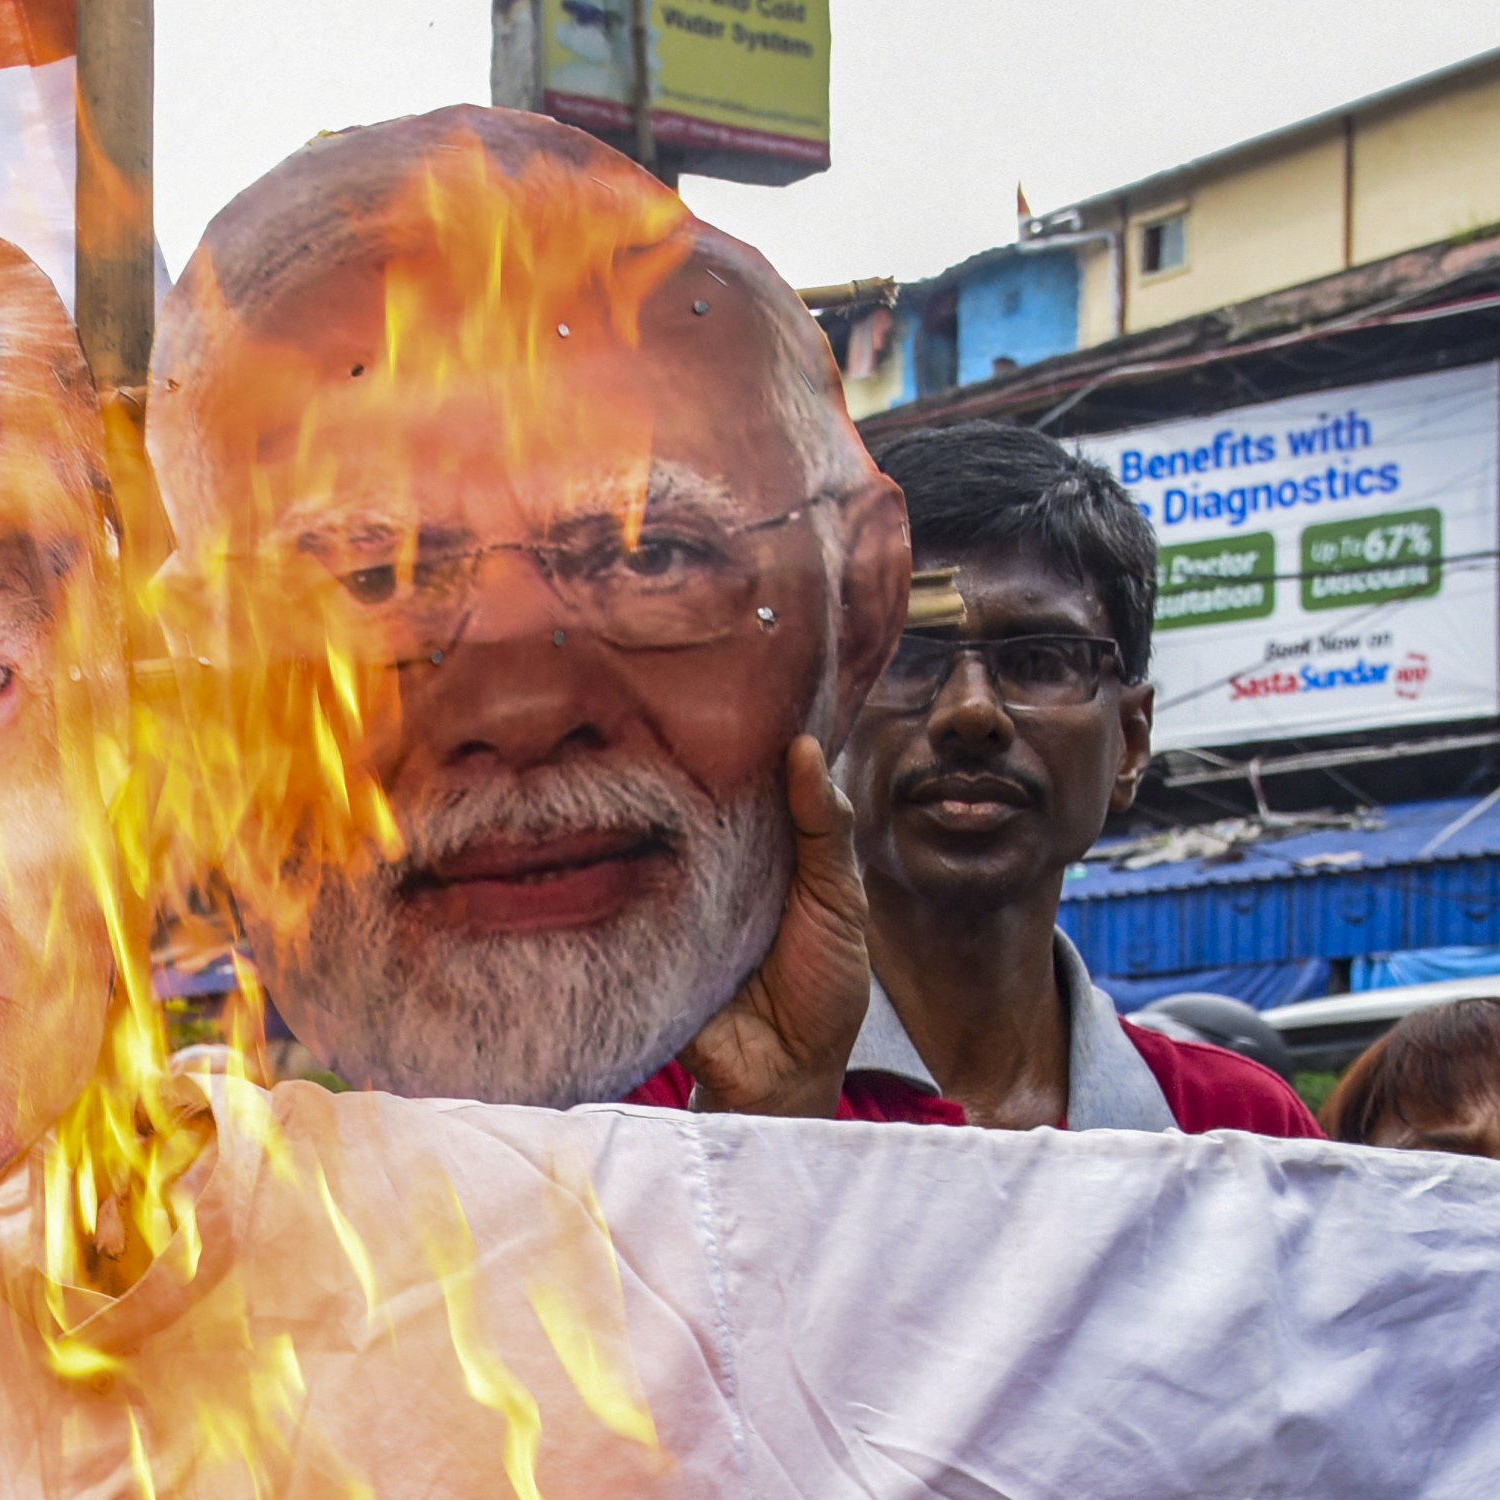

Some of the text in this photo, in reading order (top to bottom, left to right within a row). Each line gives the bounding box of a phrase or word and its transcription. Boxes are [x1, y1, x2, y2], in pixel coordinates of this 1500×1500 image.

[1120, 409, 1371, 484] Benefits with
[1163, 460, 1400, 527] Diagnostics
[1362, 521, 1432, 563] 67%
[1169, 549, 1260, 586] Doctor
[1229, 656, 1391, 701] SastaSundar
